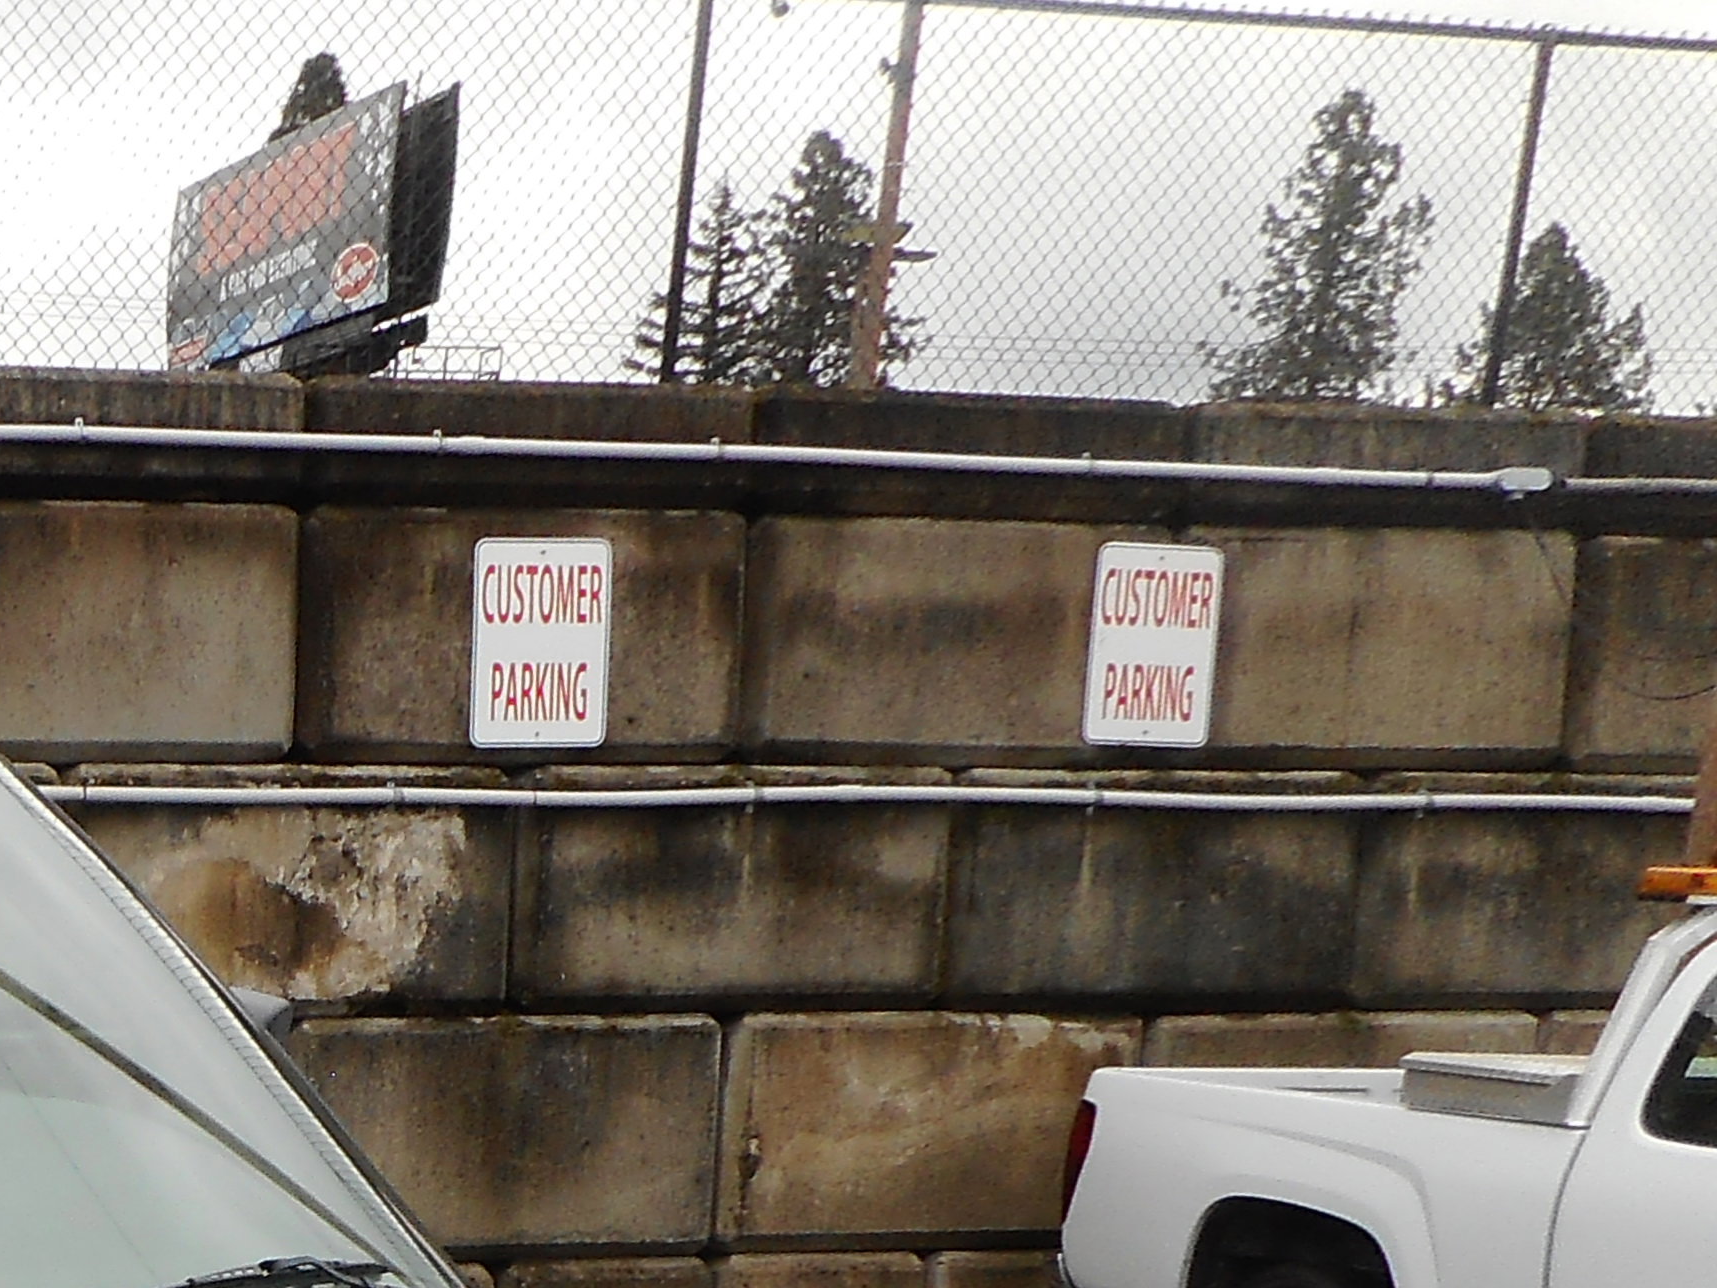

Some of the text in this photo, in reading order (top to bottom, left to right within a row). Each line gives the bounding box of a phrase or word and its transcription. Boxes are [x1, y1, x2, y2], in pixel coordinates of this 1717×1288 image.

[481, 563, 604, 625] CUSTOMER
[1100, 566, 1215, 630] CUSTOMER
[489, 661, 589, 722] PARKING
[1100, 662, 1198, 722] PARKING
